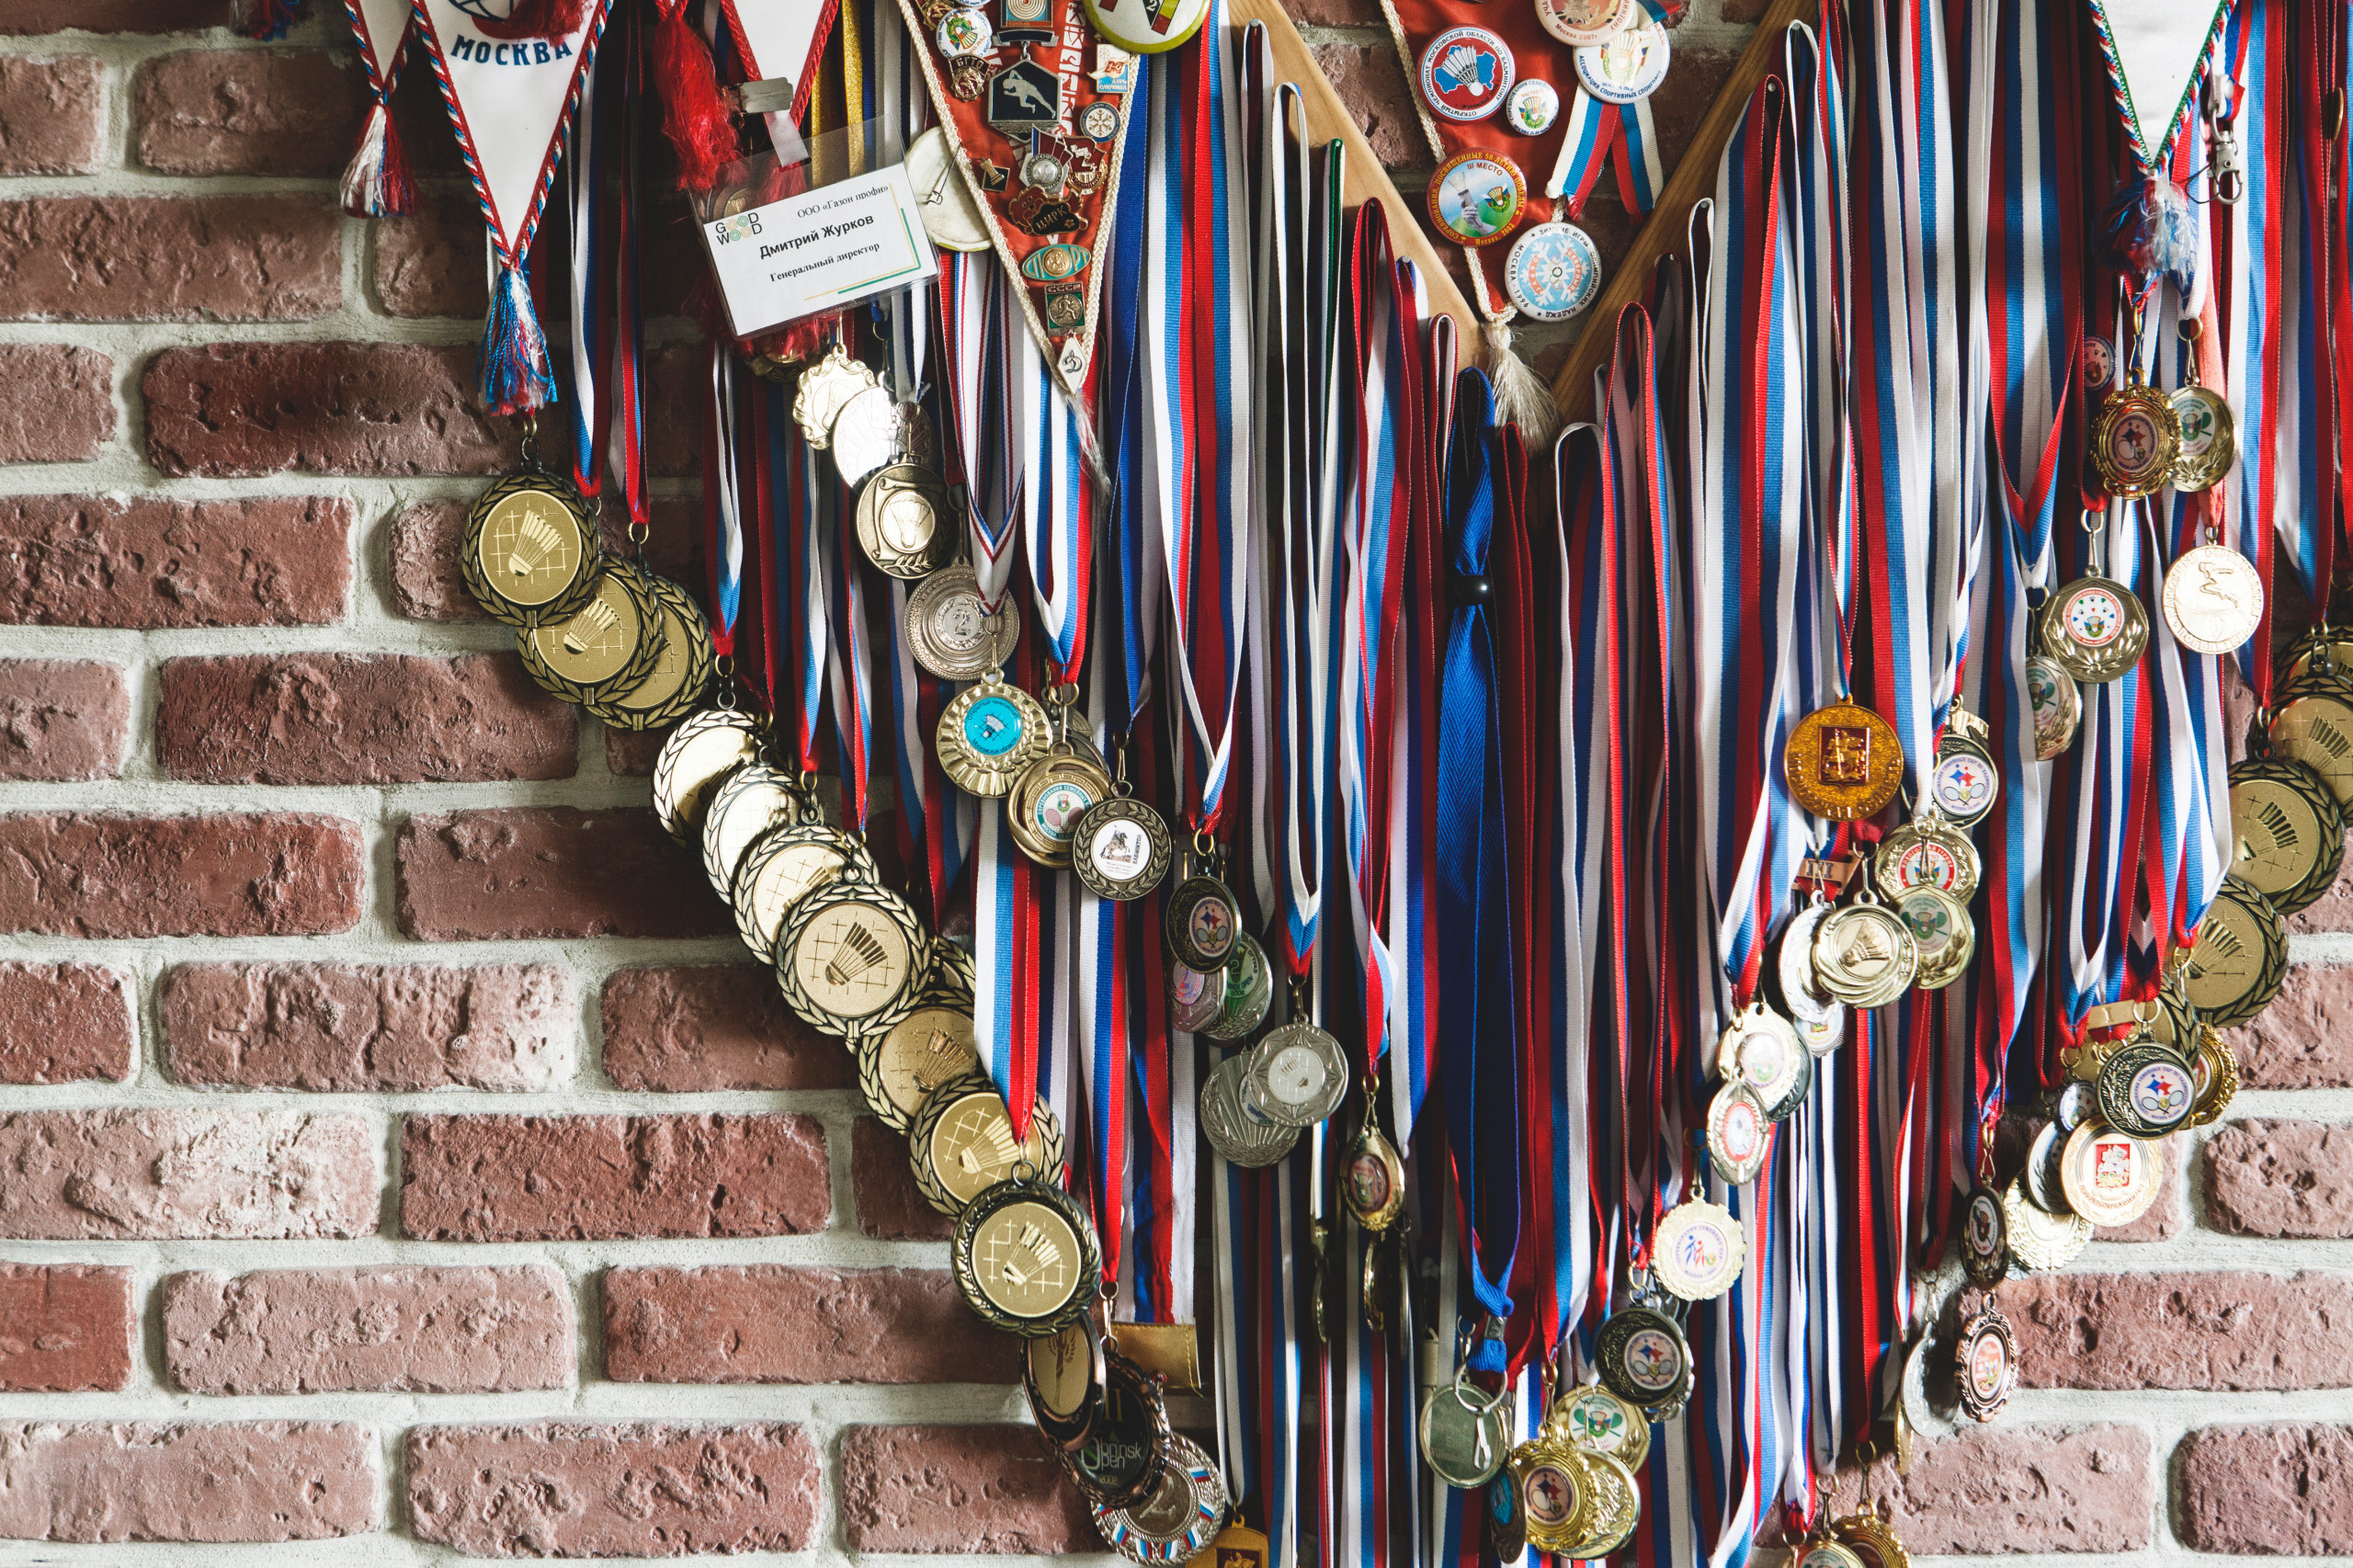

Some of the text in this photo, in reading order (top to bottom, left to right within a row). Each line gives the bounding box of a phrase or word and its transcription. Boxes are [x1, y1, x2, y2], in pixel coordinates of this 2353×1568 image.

[1554, 23, 1577, 39] Москва
[450, 34, 573, 66] МОСКВА
[956, 56, 984, 70] БГТО
[1425, 30, 1508, 118] ОТКРЫТЫЙ ЧЕМПИОНАТ МОСКОВСКОЙ ОБЛАСТИ ПО БАДМИНТОНУ
[1578, 54, 1600, 90] АССОЦИАЦИЯ
[1599, 87, 1637, 99] СПОРТИВНЫХ
[1435, 152, 1483, 185] ПОСВЯЩЕННЫЕ
[1514, 176, 1525, 208] ПОБЕДЫ
[1476, 162, 1503, 176] МЕСТО
[797, 204, 821, 219] ООО
[1035, 205, 1066, 231] ЦИРК
[759, 214, 874, 259] Дмитрий Журков
[1572, 231, 1589, 247] ИГРЫ
[769, 242, 881, 282] Генеральный директор
[1510, 244, 1525, 281] МОСКВА
[1047, 282, 1082, 294] СССР
[1545, 306, 1576, 318] НАДЕЖД
[952, 608, 972, 636] 2
[967, 699, 1018, 721] Открытый чемпионат
[972, 736, 1017, 754] Московской области
[1938, 847, 1953, 869] ТУРНИР
[1230, 959, 1241, 975] 2
